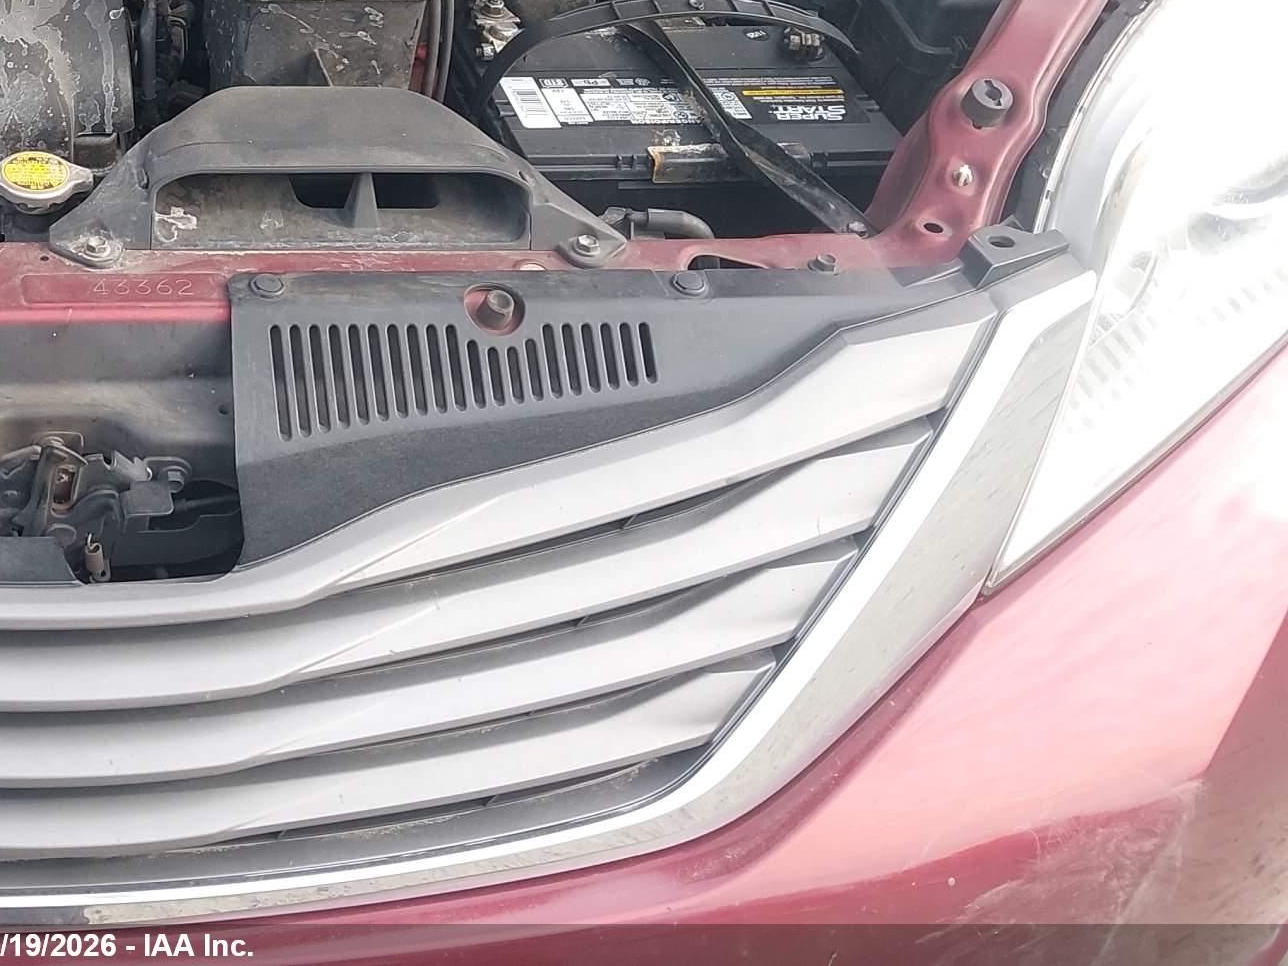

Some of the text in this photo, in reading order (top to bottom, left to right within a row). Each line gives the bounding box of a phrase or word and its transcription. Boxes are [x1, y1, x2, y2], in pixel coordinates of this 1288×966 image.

[772, 104, 847, 114] START
[775, 113, 844, 121] SUPER
[92, 277, 195, 295] 43362
